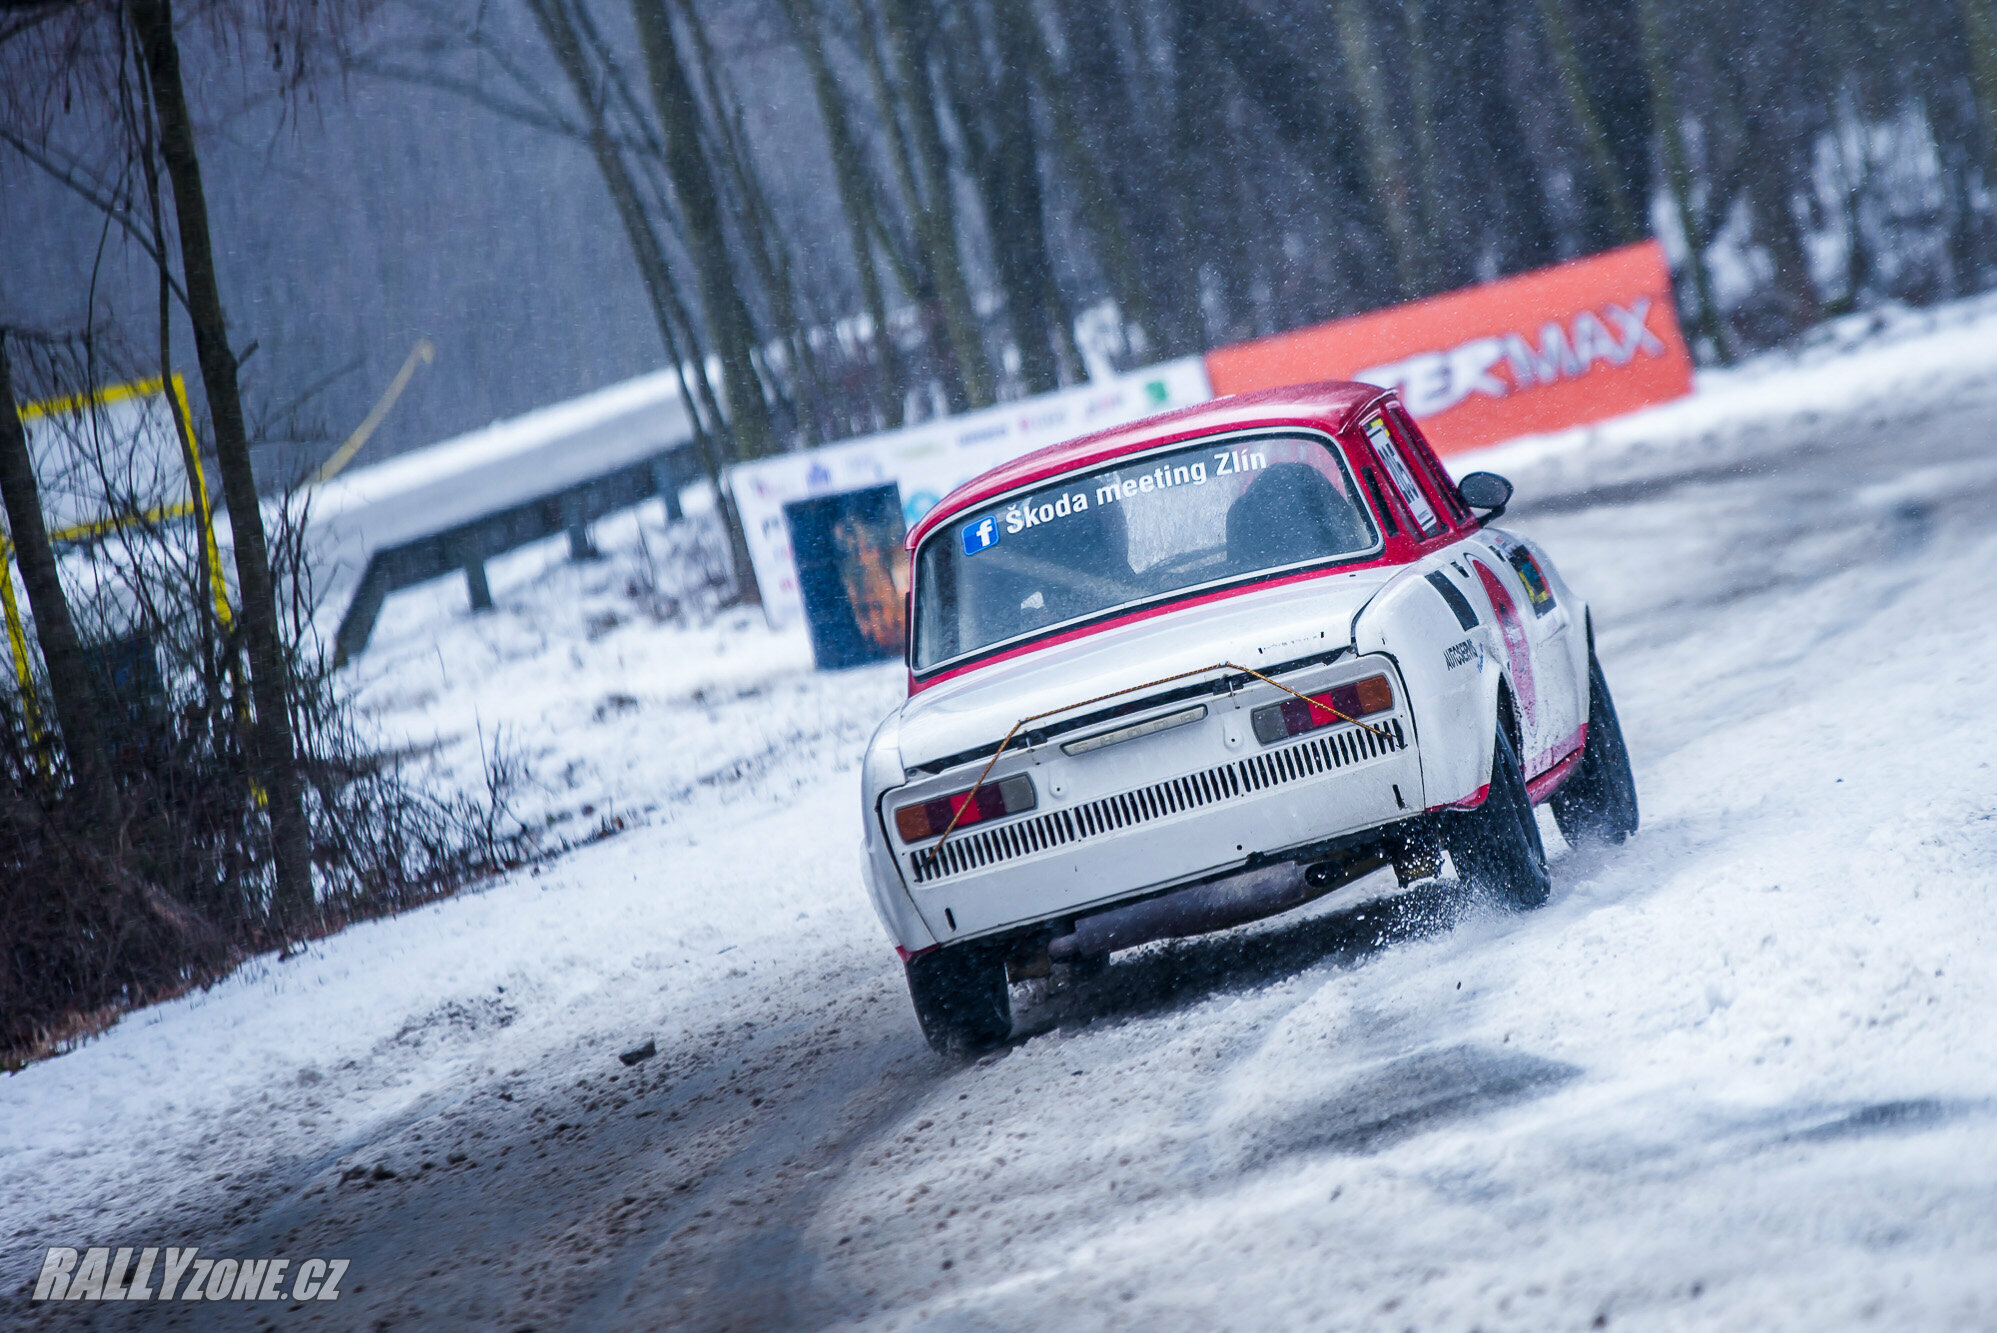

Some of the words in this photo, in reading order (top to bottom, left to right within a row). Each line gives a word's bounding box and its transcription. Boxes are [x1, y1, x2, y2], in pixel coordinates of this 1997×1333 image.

[1006, 491, 1088, 535] Škoda
[1096, 462, 1207, 505] meeting
[1214, 448, 1267, 477] Zlín
